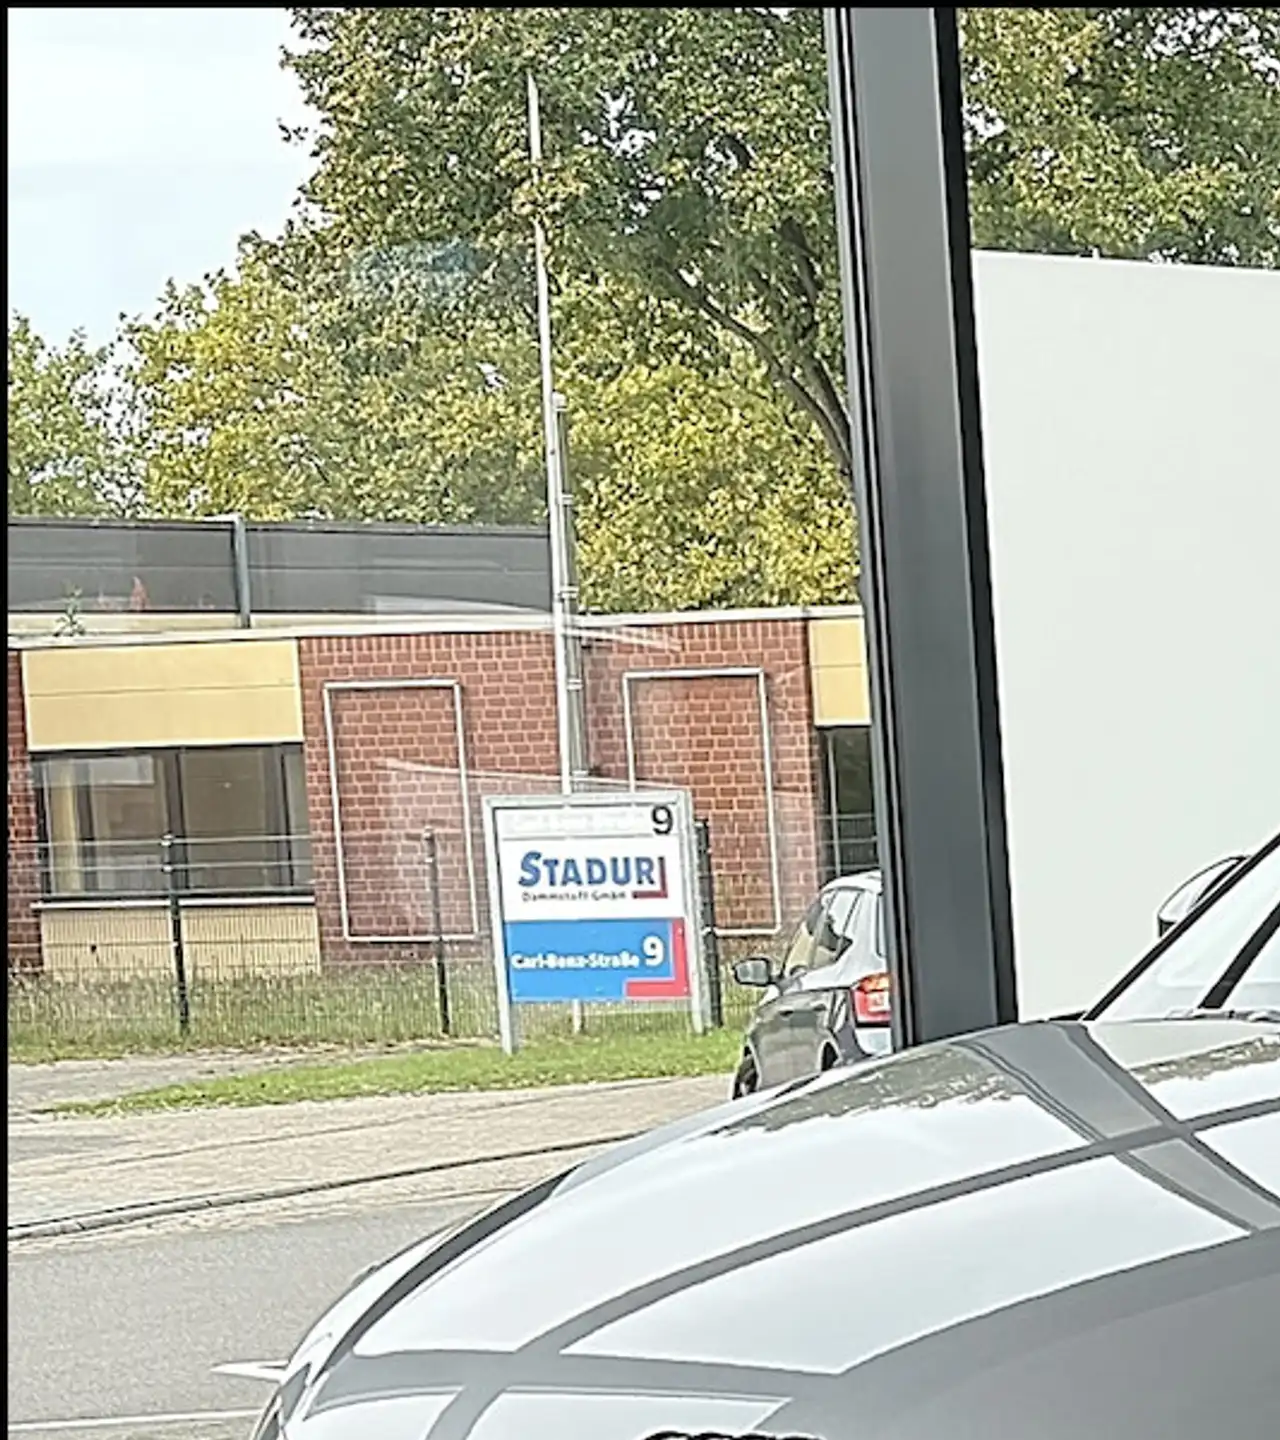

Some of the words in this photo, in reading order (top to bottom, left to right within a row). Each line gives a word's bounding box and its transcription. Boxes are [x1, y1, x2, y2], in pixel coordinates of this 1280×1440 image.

[651, 804, 674, 836] 9
[517, 850, 656, 888] STADUR
[642, 935, 666, 968] 9
